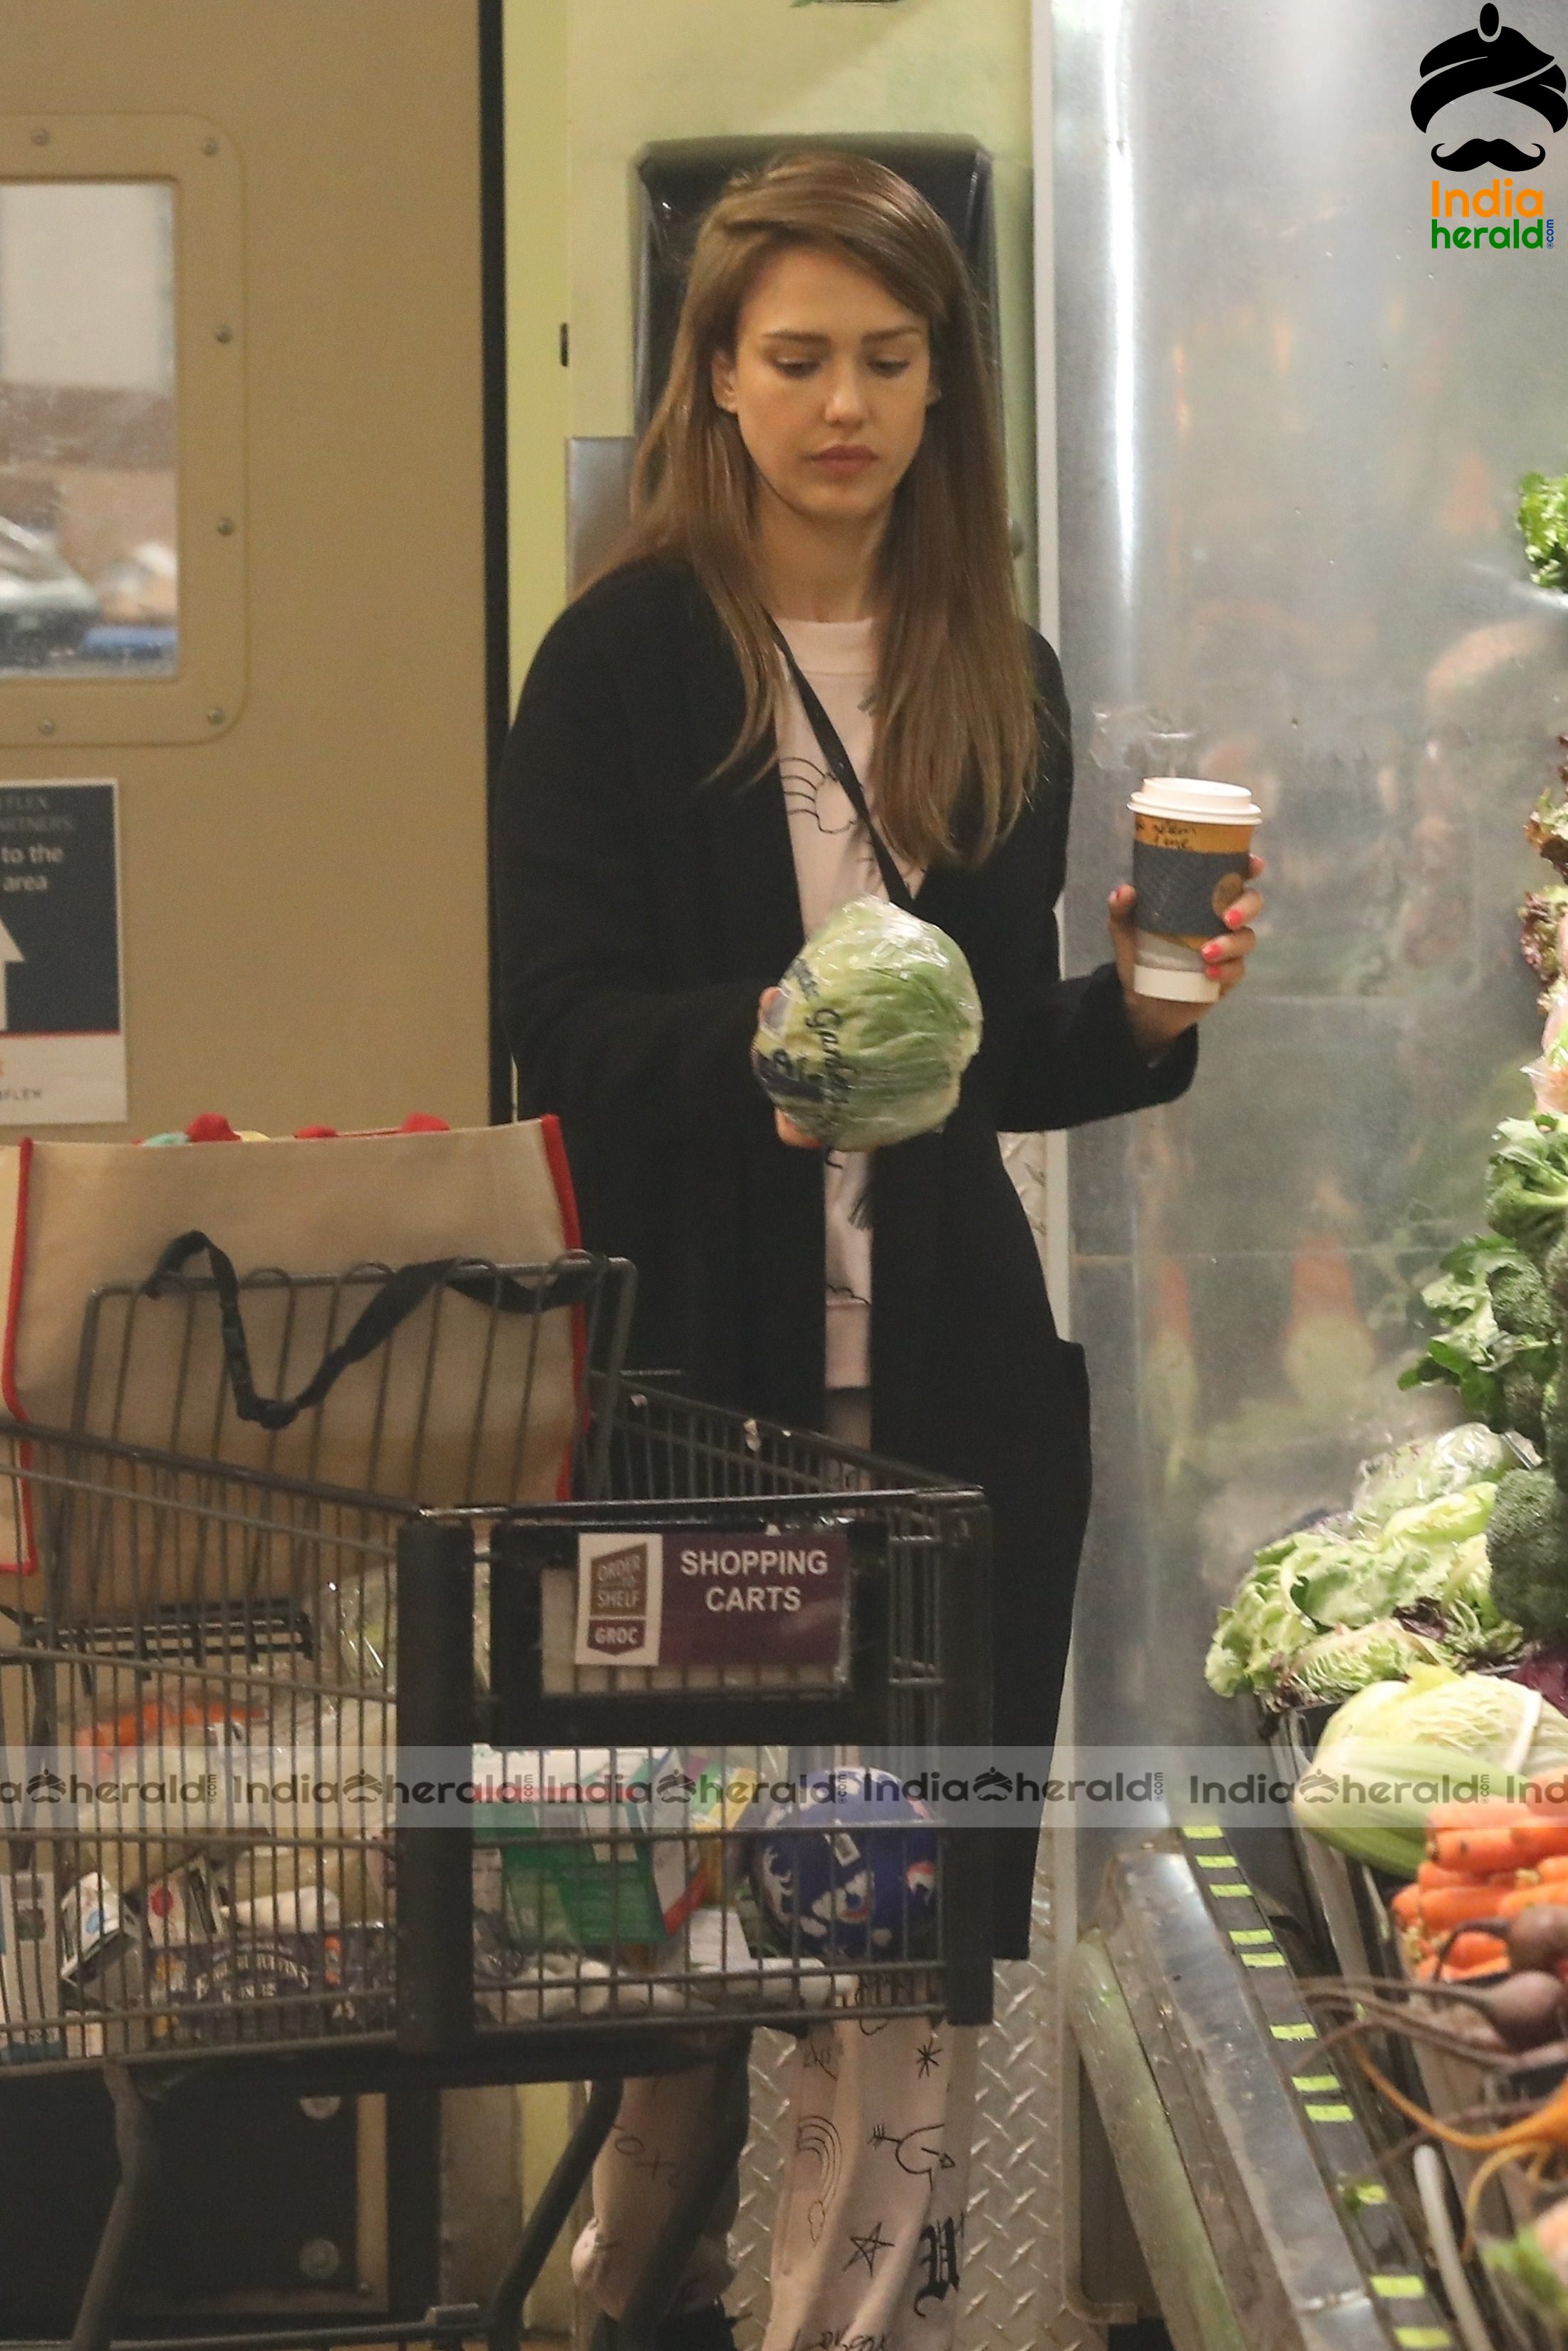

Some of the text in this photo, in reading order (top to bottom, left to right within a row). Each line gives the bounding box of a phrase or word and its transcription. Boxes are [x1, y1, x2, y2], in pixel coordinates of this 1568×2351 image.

[1, 843, 63, 863] to the
[680, 1549, 829, 1576] SHOPPING
[705, 1586, 801, 1612] CARTS
[594, 1626, 638, 1644] GROC
